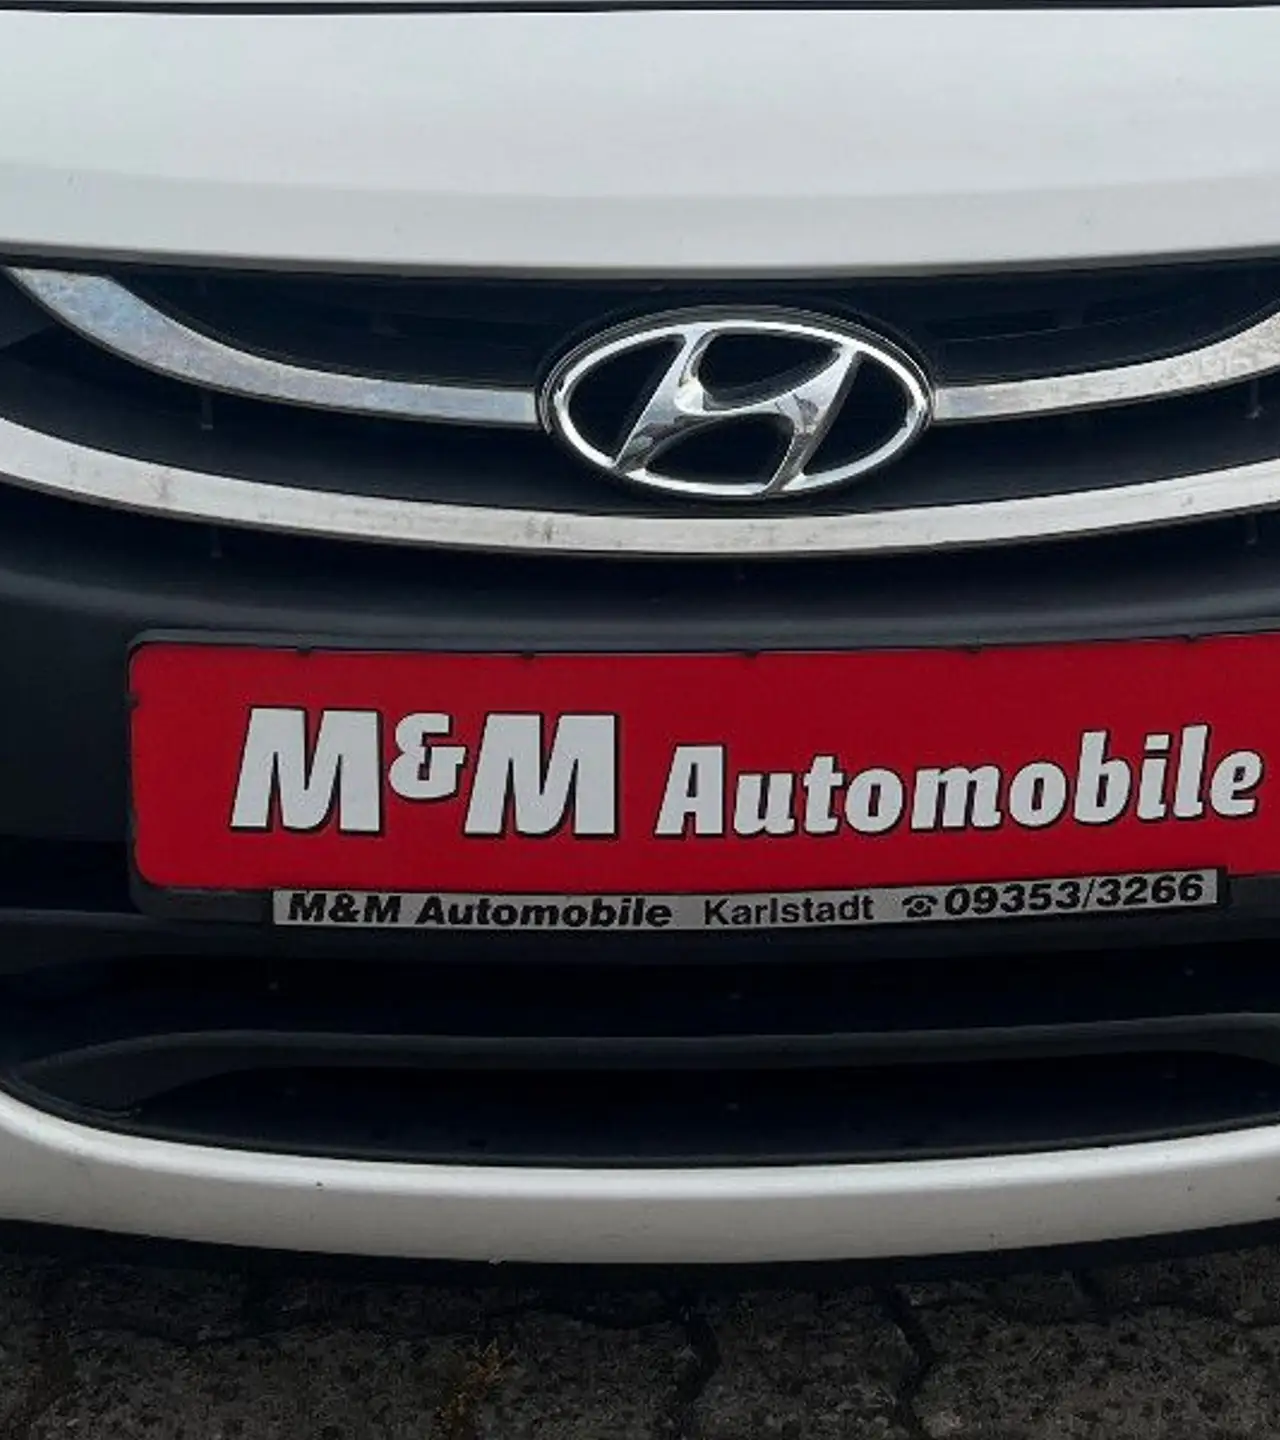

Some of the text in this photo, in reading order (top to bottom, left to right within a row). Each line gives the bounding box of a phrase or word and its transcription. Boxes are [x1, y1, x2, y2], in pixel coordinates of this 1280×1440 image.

[228, 705, 1266, 839] M&M Automobile
[286, 872, 1206, 928] M&M Automobile Karlstadt 09353/3266
